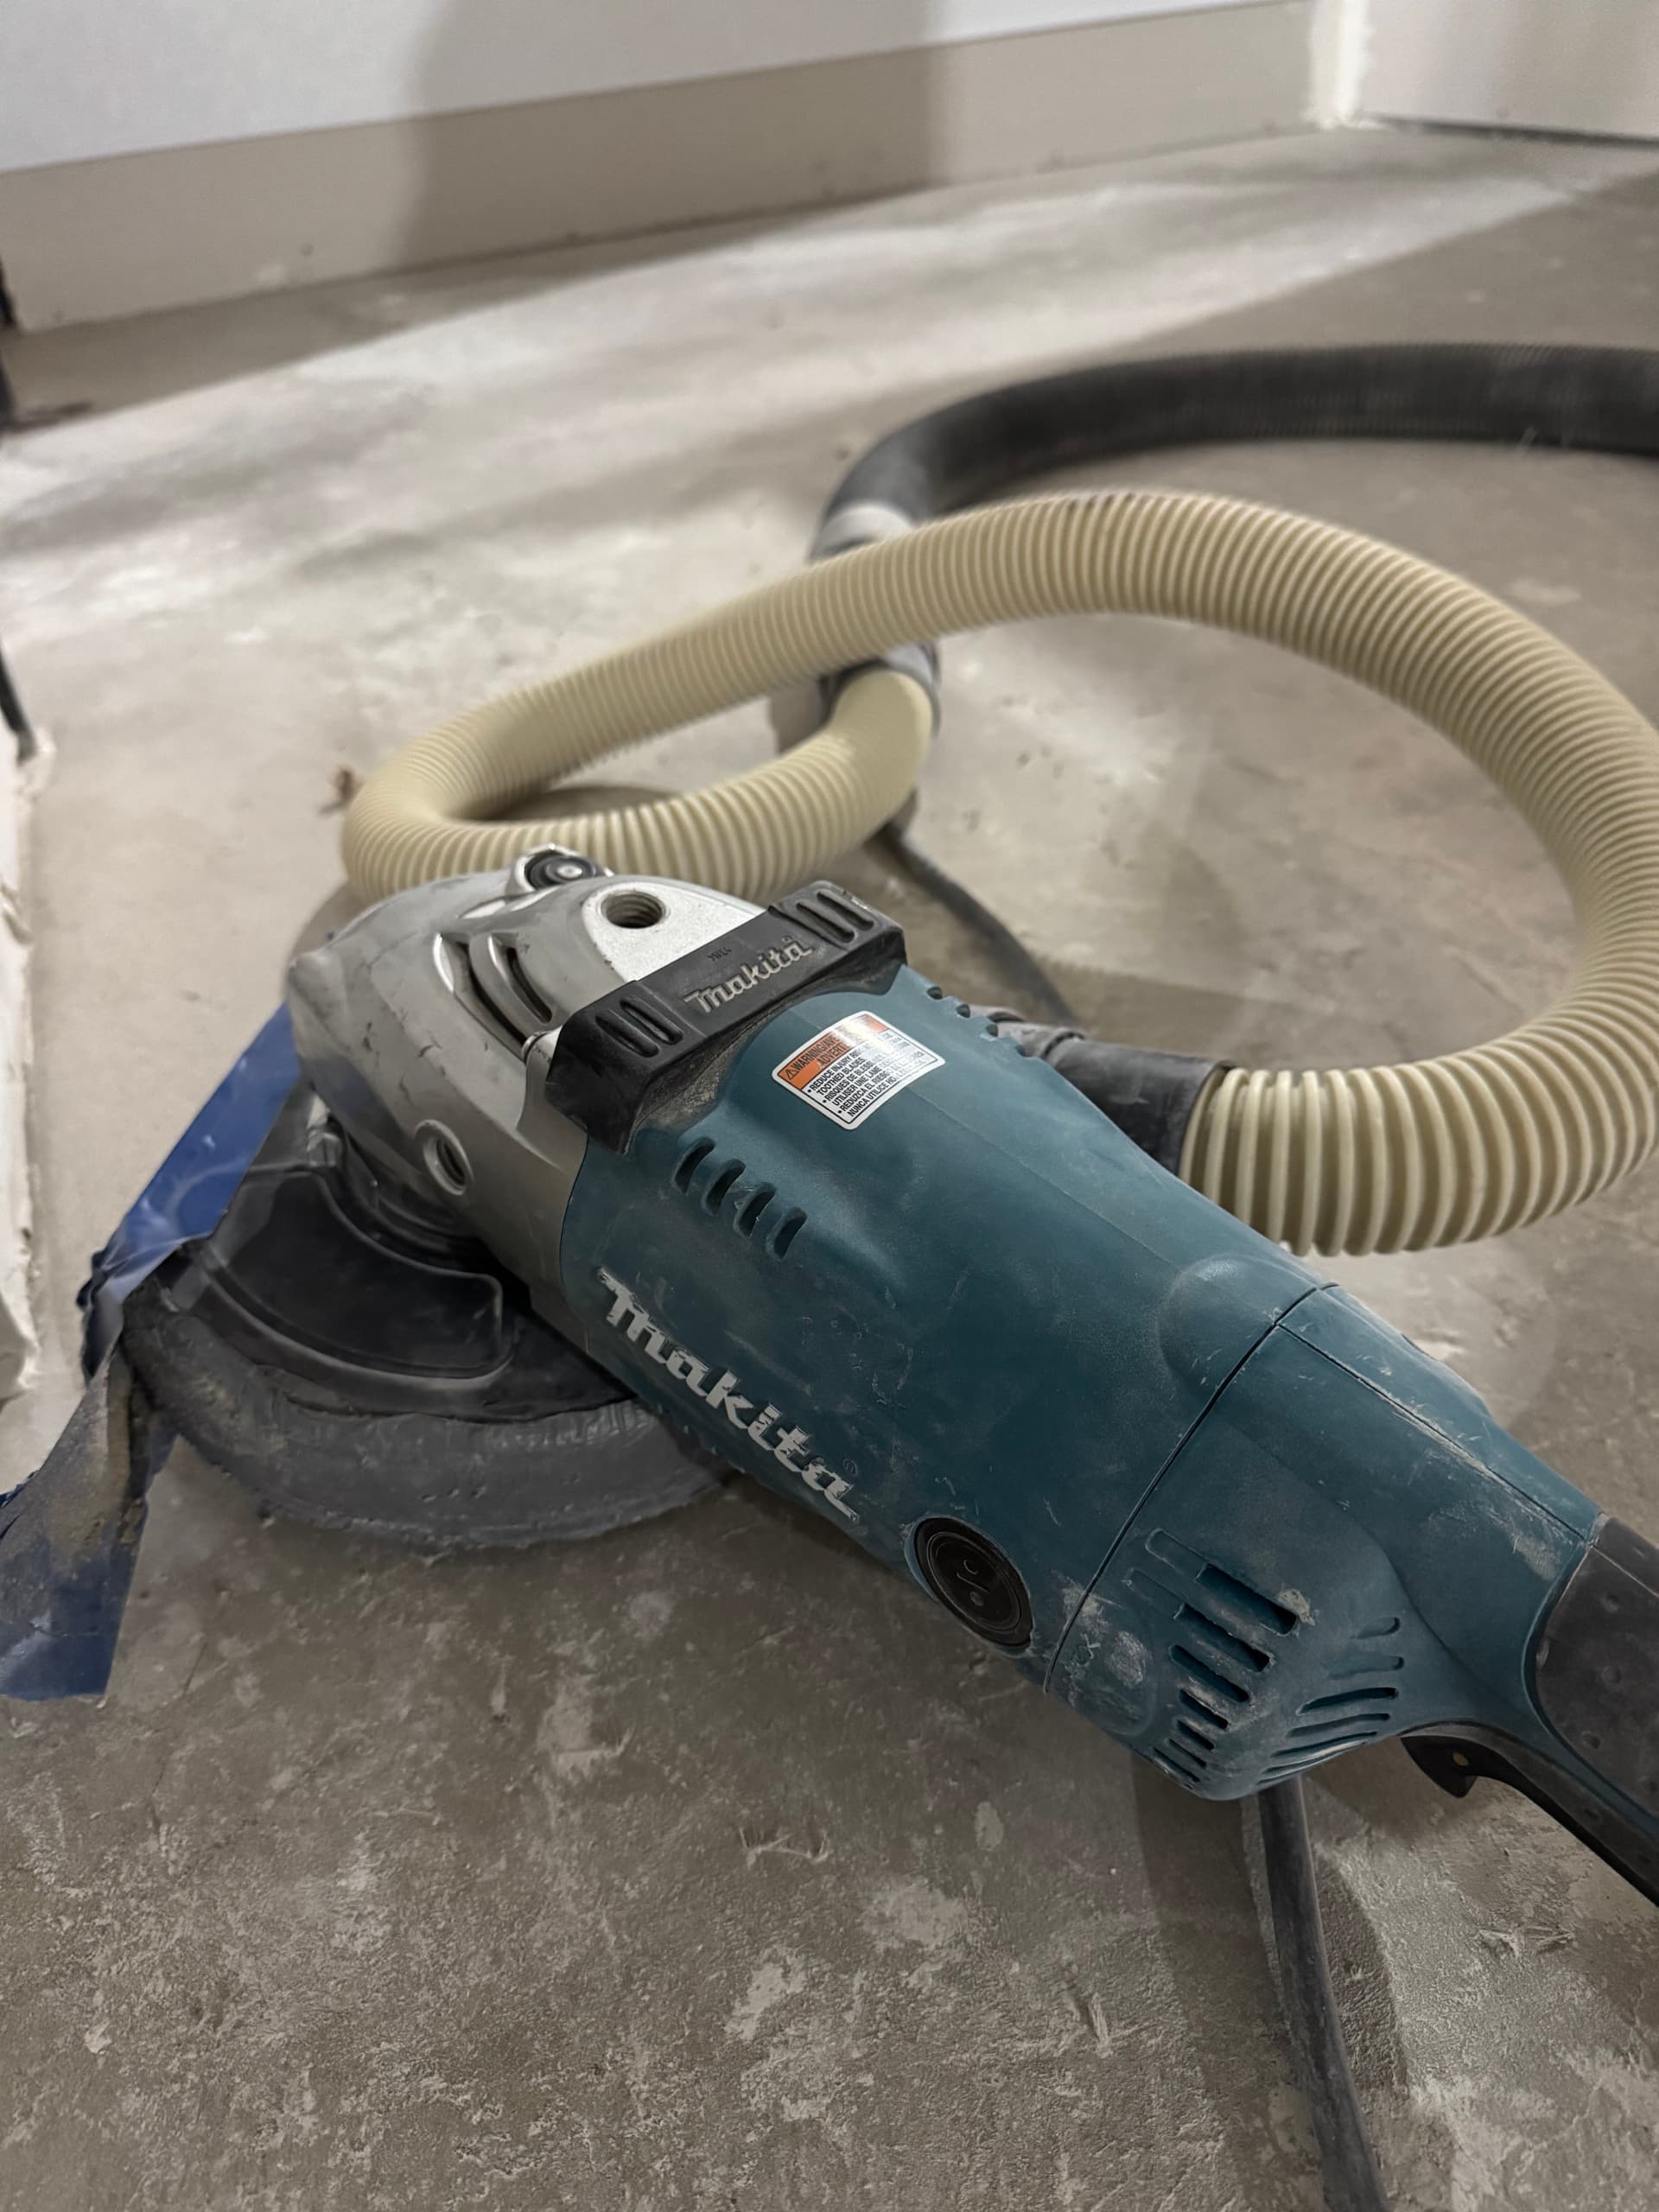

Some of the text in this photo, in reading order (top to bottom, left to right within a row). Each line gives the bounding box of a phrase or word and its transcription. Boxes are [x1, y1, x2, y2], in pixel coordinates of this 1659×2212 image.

[683, 941, 813, 1013] Makita
[810, 1069, 836, 1090] REDUCE
[830, 1055, 853, 1072] INJURY
[816, 1071, 845, 1096] TOOTHED
[823, 1078, 850, 1101] RISQUES
[845, 1072, 858, 1082] DE
[830, 1084, 858, 1106] UTILISER
[853, 1075, 868, 1087] UNE
[864, 1065, 883, 1078] LAME
[838, 1086, 868, 1111] REDUZCA
[863, 1081, 875, 1090] EL
[846, 1096, 870, 1117] NUNCA
[864, 1081, 889, 1100] UTILICE
[598, 1267, 860, 1522] Makita
